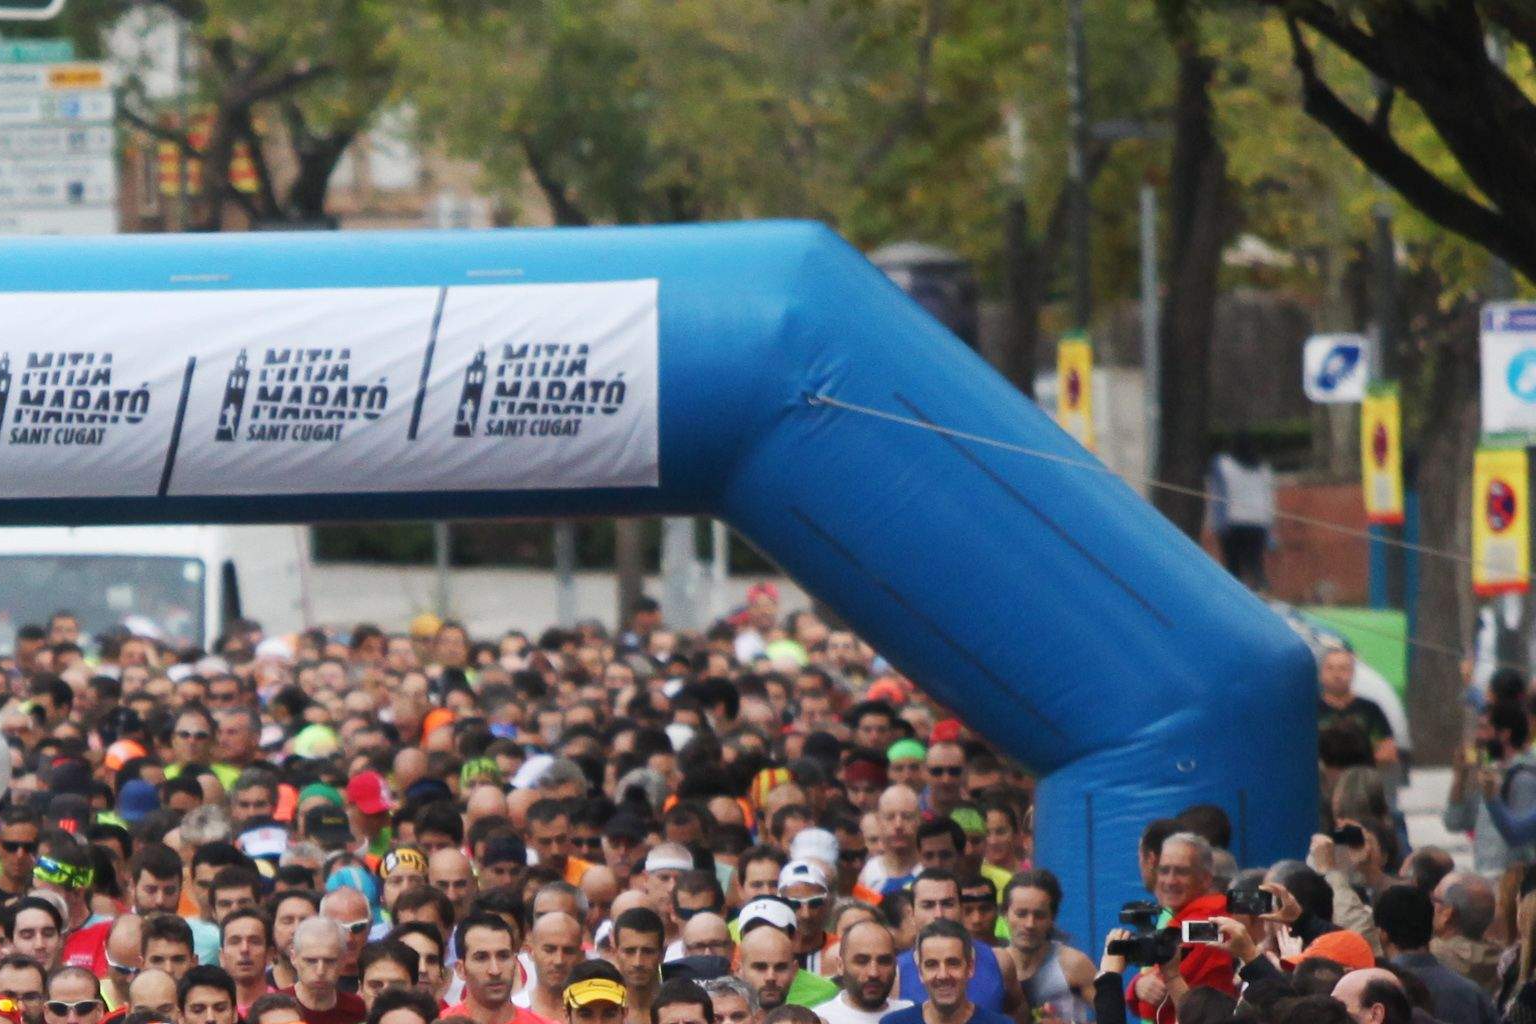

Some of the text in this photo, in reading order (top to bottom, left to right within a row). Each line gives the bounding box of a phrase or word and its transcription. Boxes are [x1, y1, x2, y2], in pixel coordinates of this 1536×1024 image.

[21, 352, 114, 387] MITJA
[259, 348, 351, 383] MITJA
[496, 343, 589, 378] MITJA
[12, 381, 151, 425] MARATÓ
[250, 376, 389, 421] MARATÓ
[488, 371, 627, 416] MARATÓ
[8, 427, 106, 446] SANT CUGAT
[246, 423, 343, 442] SANT CUGAT
[483, 418, 582, 438] SANT CUGAT
